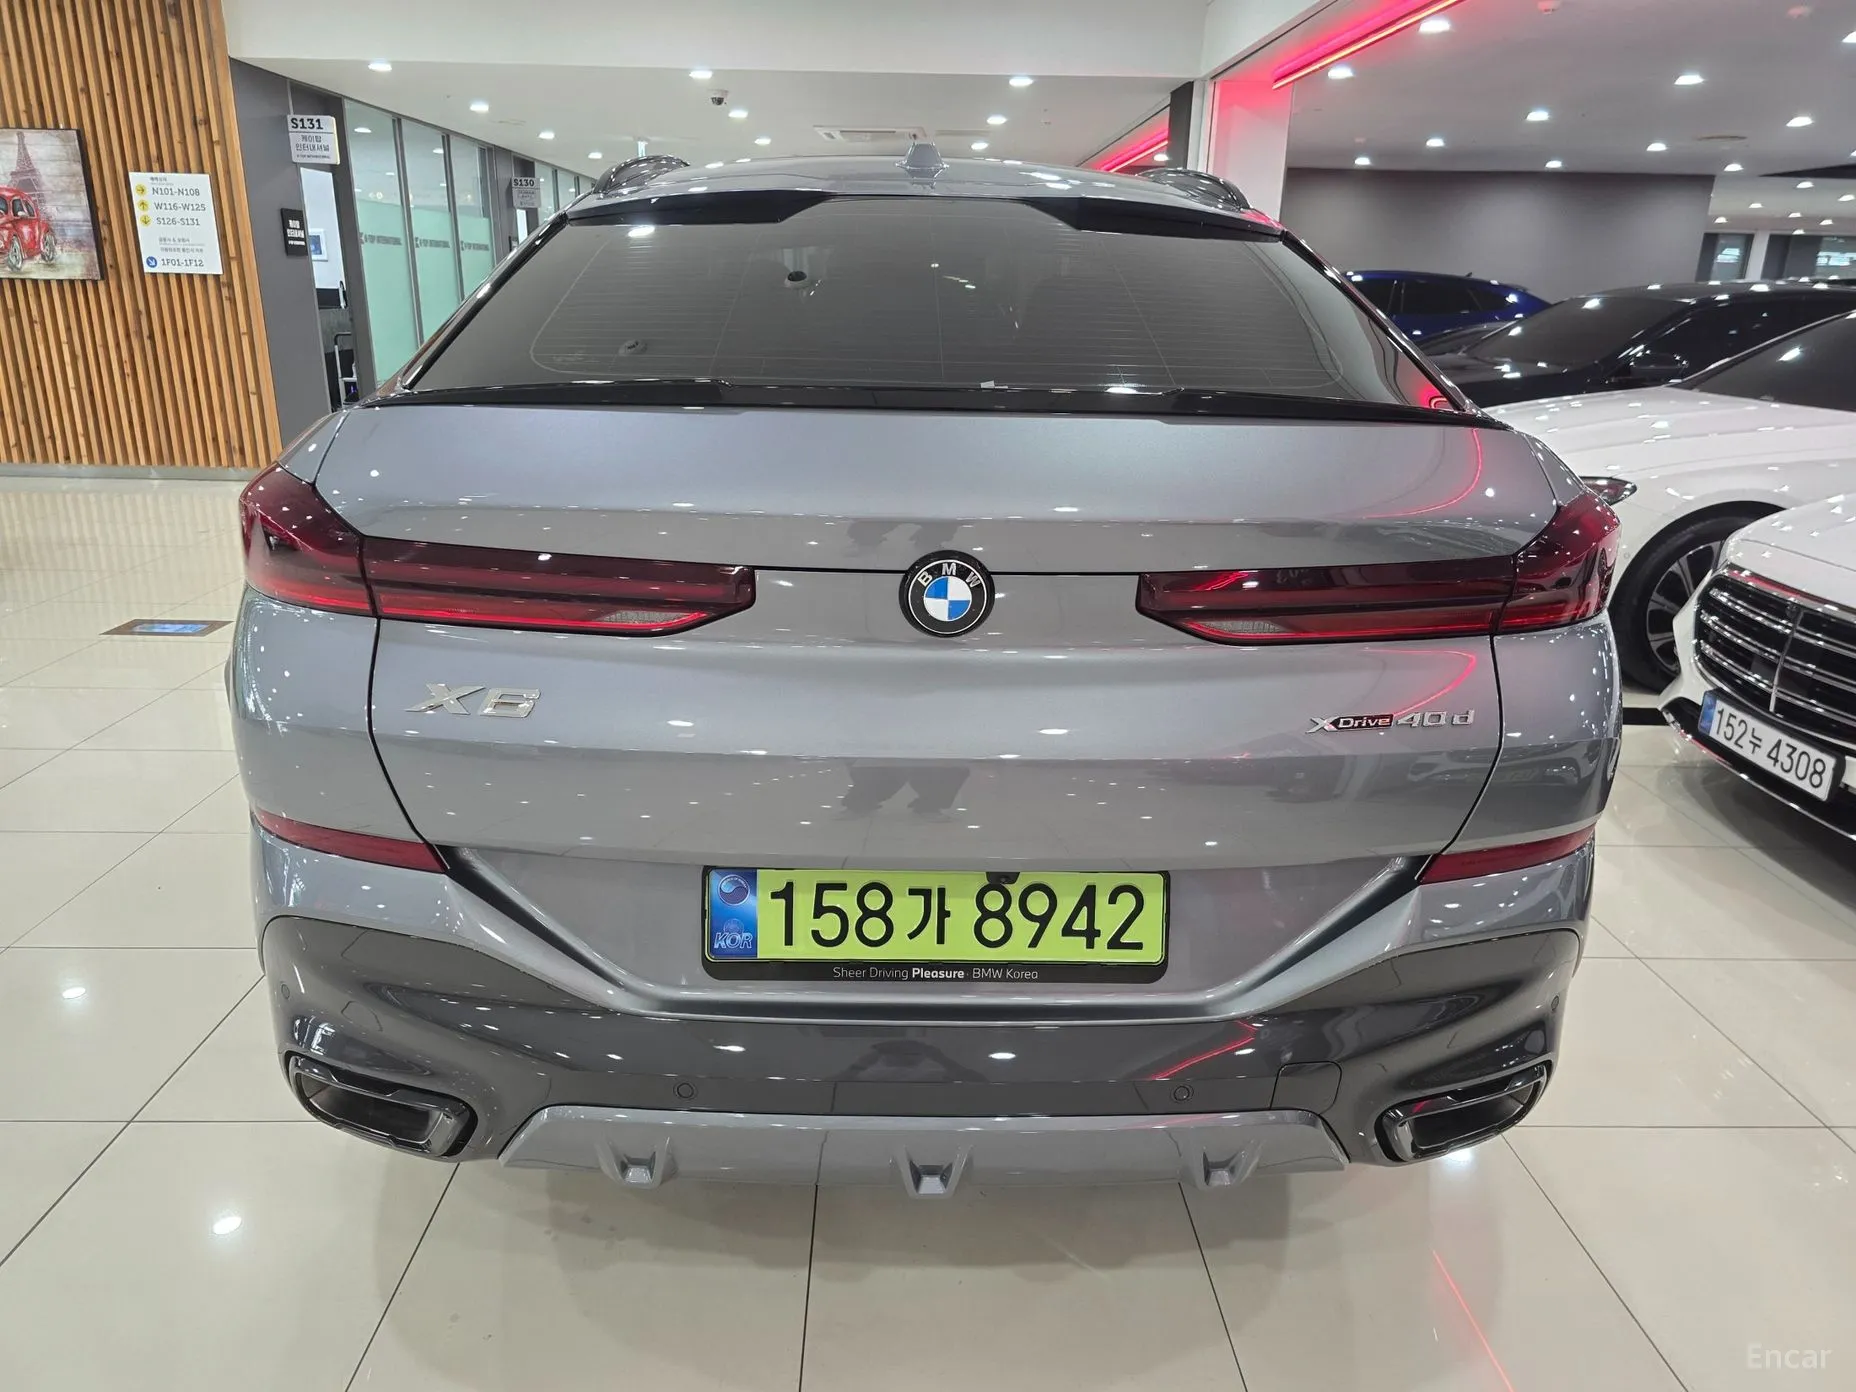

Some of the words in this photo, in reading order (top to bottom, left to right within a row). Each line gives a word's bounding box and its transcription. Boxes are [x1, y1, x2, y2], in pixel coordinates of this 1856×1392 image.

[290, 117, 324, 130] S131
[513, 178, 535, 187] S130
[152, 187, 200, 197] N101-N108
[154, 202, 206, 212] W116-W125
[156, 217, 200, 226] S126-S131
[161, 258, 204, 268] 1F01-1F12
[917, 562, 981, 588] BMW
[404, 683, 541, 718] X6
[1715, 708, 1763, 755] 152누
[1766, 738, 1827, 789] 4308
[770, 880, 951, 948] 158가
[973, 882, 1145, 950] 8942
[714, 932, 753, 949] KOR
[832, 966, 867, 978] Sheer
[869, 966, 909, 981] Driving
[912, 967, 965, 979] Pleasure
[972, 967, 1003, 979] BMW
[1006, 968, 1039, 979] Korea
